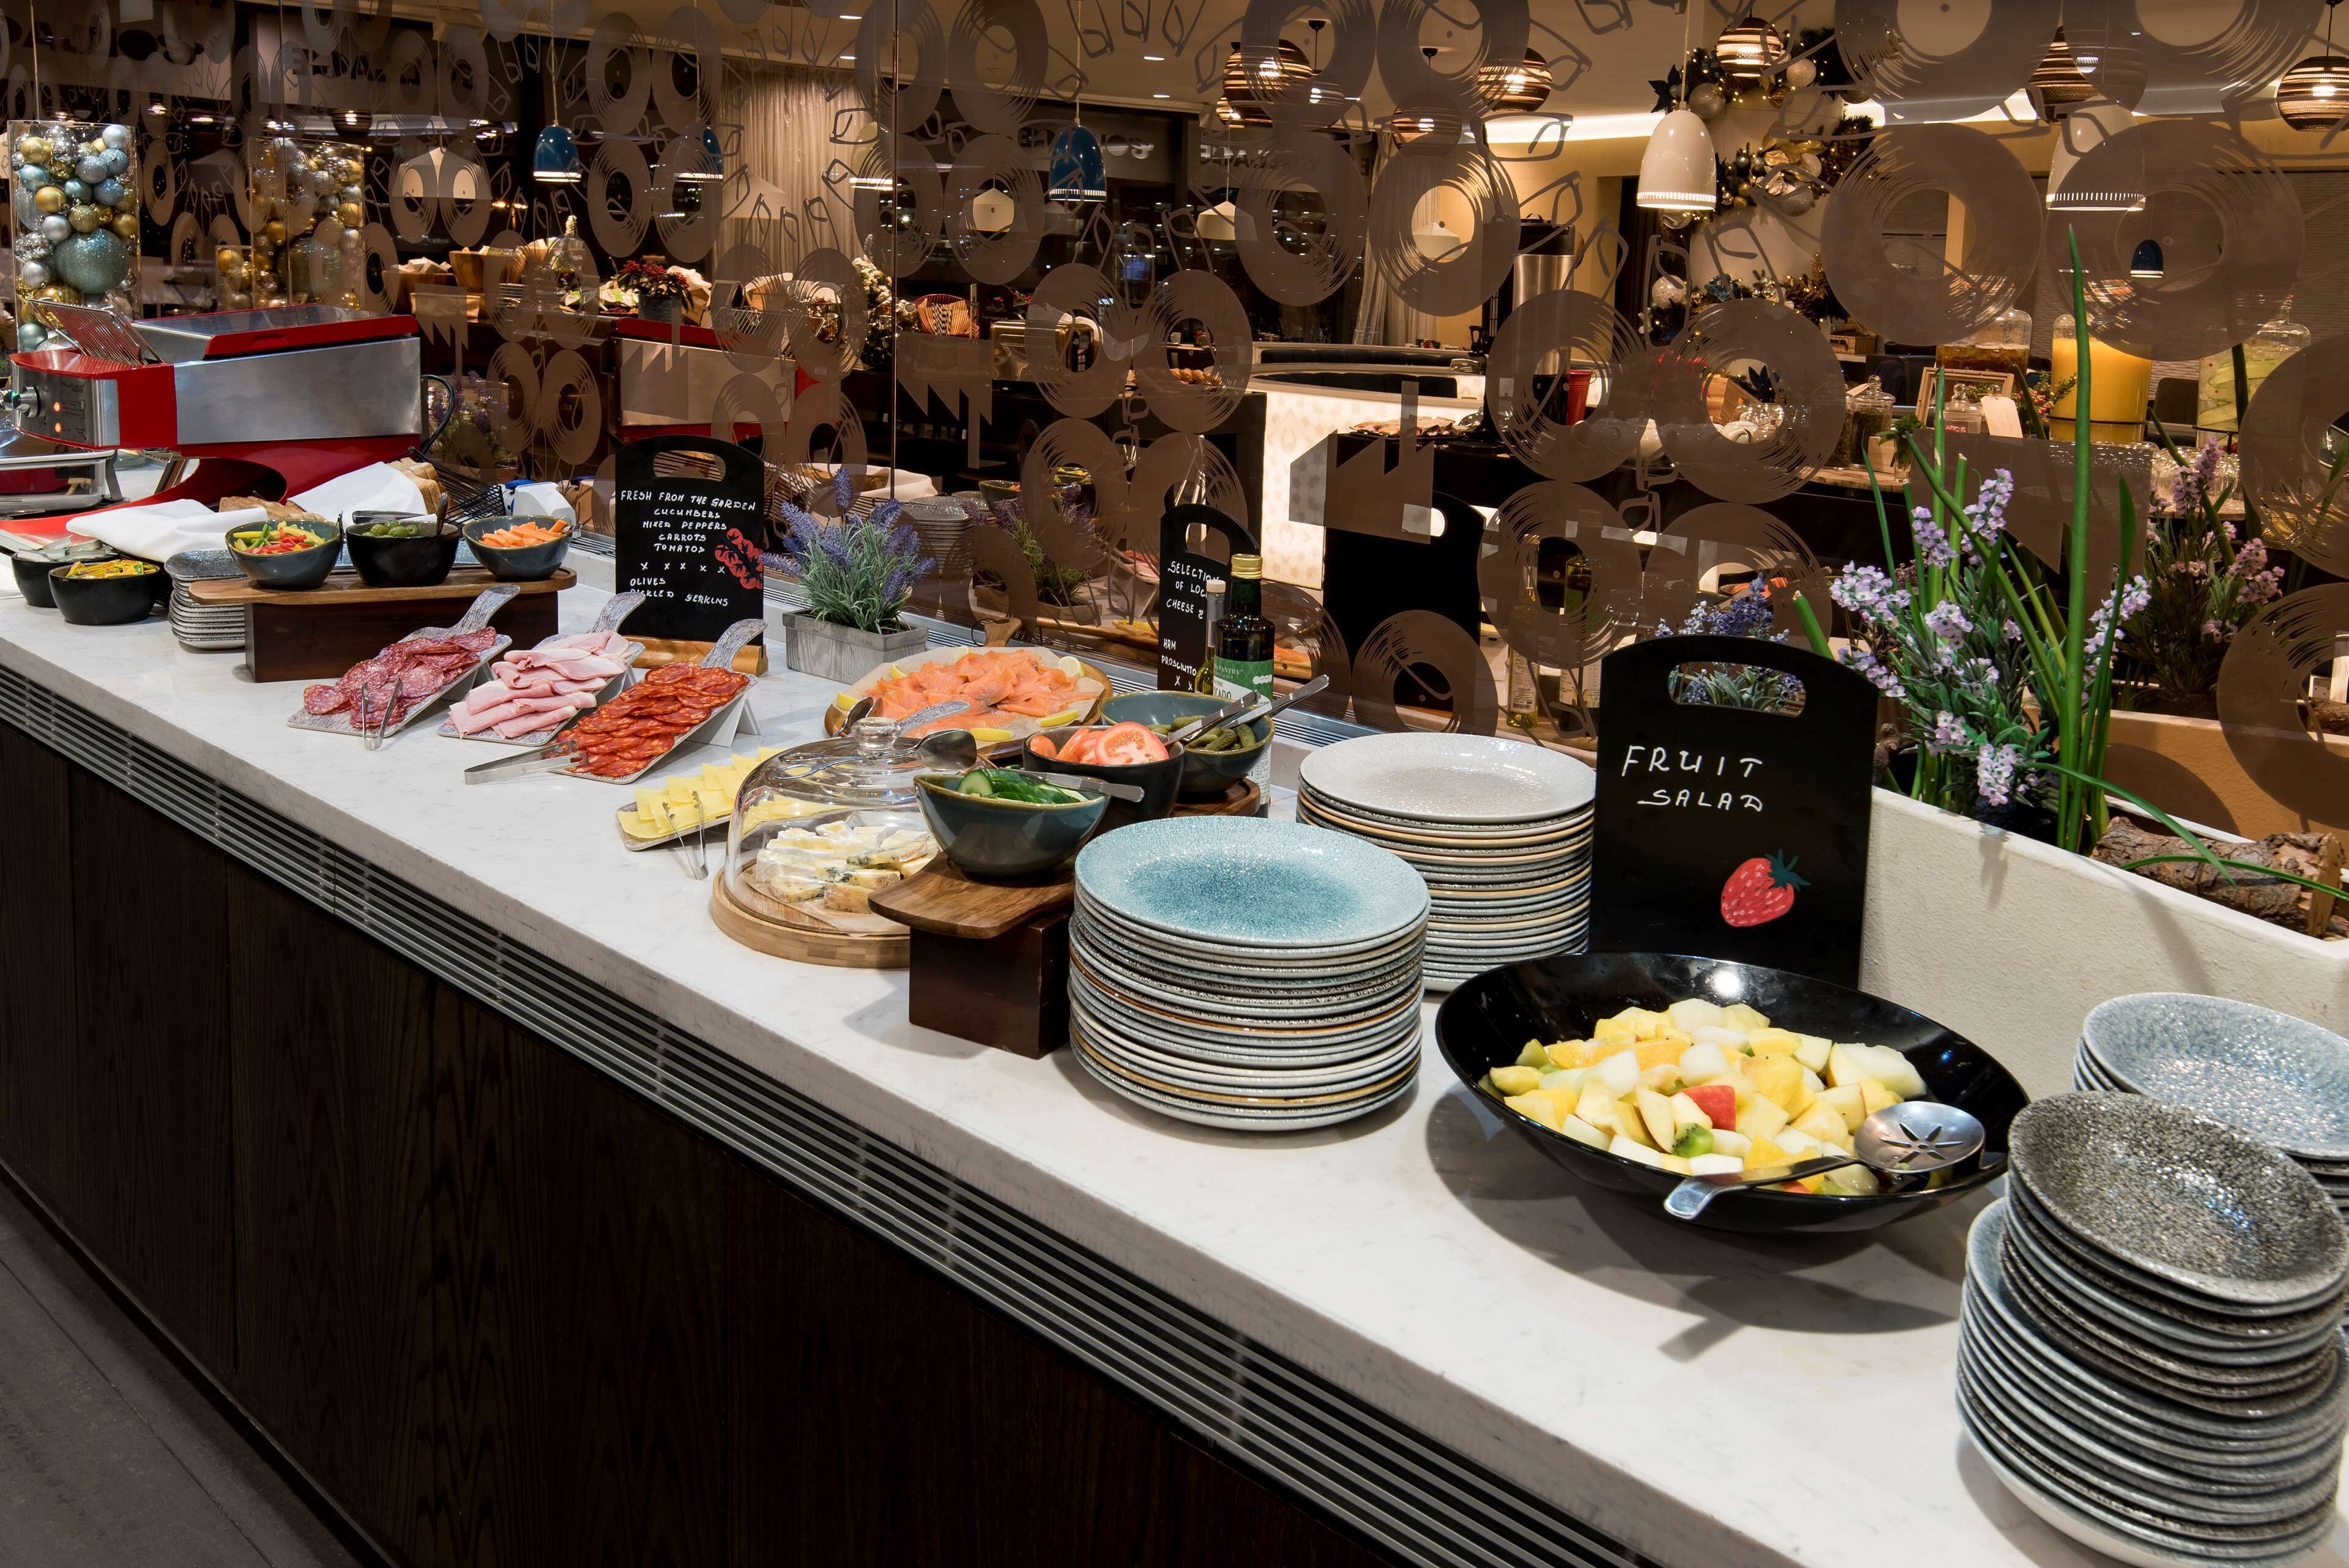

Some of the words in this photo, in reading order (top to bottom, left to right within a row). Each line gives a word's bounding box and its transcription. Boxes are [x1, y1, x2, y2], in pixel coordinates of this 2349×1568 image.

[621, 491, 652, 500] FRESH
[659, 492, 684, 502] FROM
[691, 496, 707, 504] THE
[711, 498, 755, 510] GARDEN
[654, 508, 720, 519] CUCUMBERS
[682, 521, 727, 530] PEPPERS
[654, 543, 705, 553] TOMATOS
[630, 578, 666, 586] OLIVES
[1175, 581, 1183, 590] OF
[1166, 599, 1194, 613] CHEESE
[1164, 638, 1176, 650] HAM
[1161, 655, 1196, 676] PROSCIUTTO
[1215, 687, 1231, 699] CADO
[1621, 745, 1762, 777] FRUIT
[1637, 789, 1762, 811] SALAD
